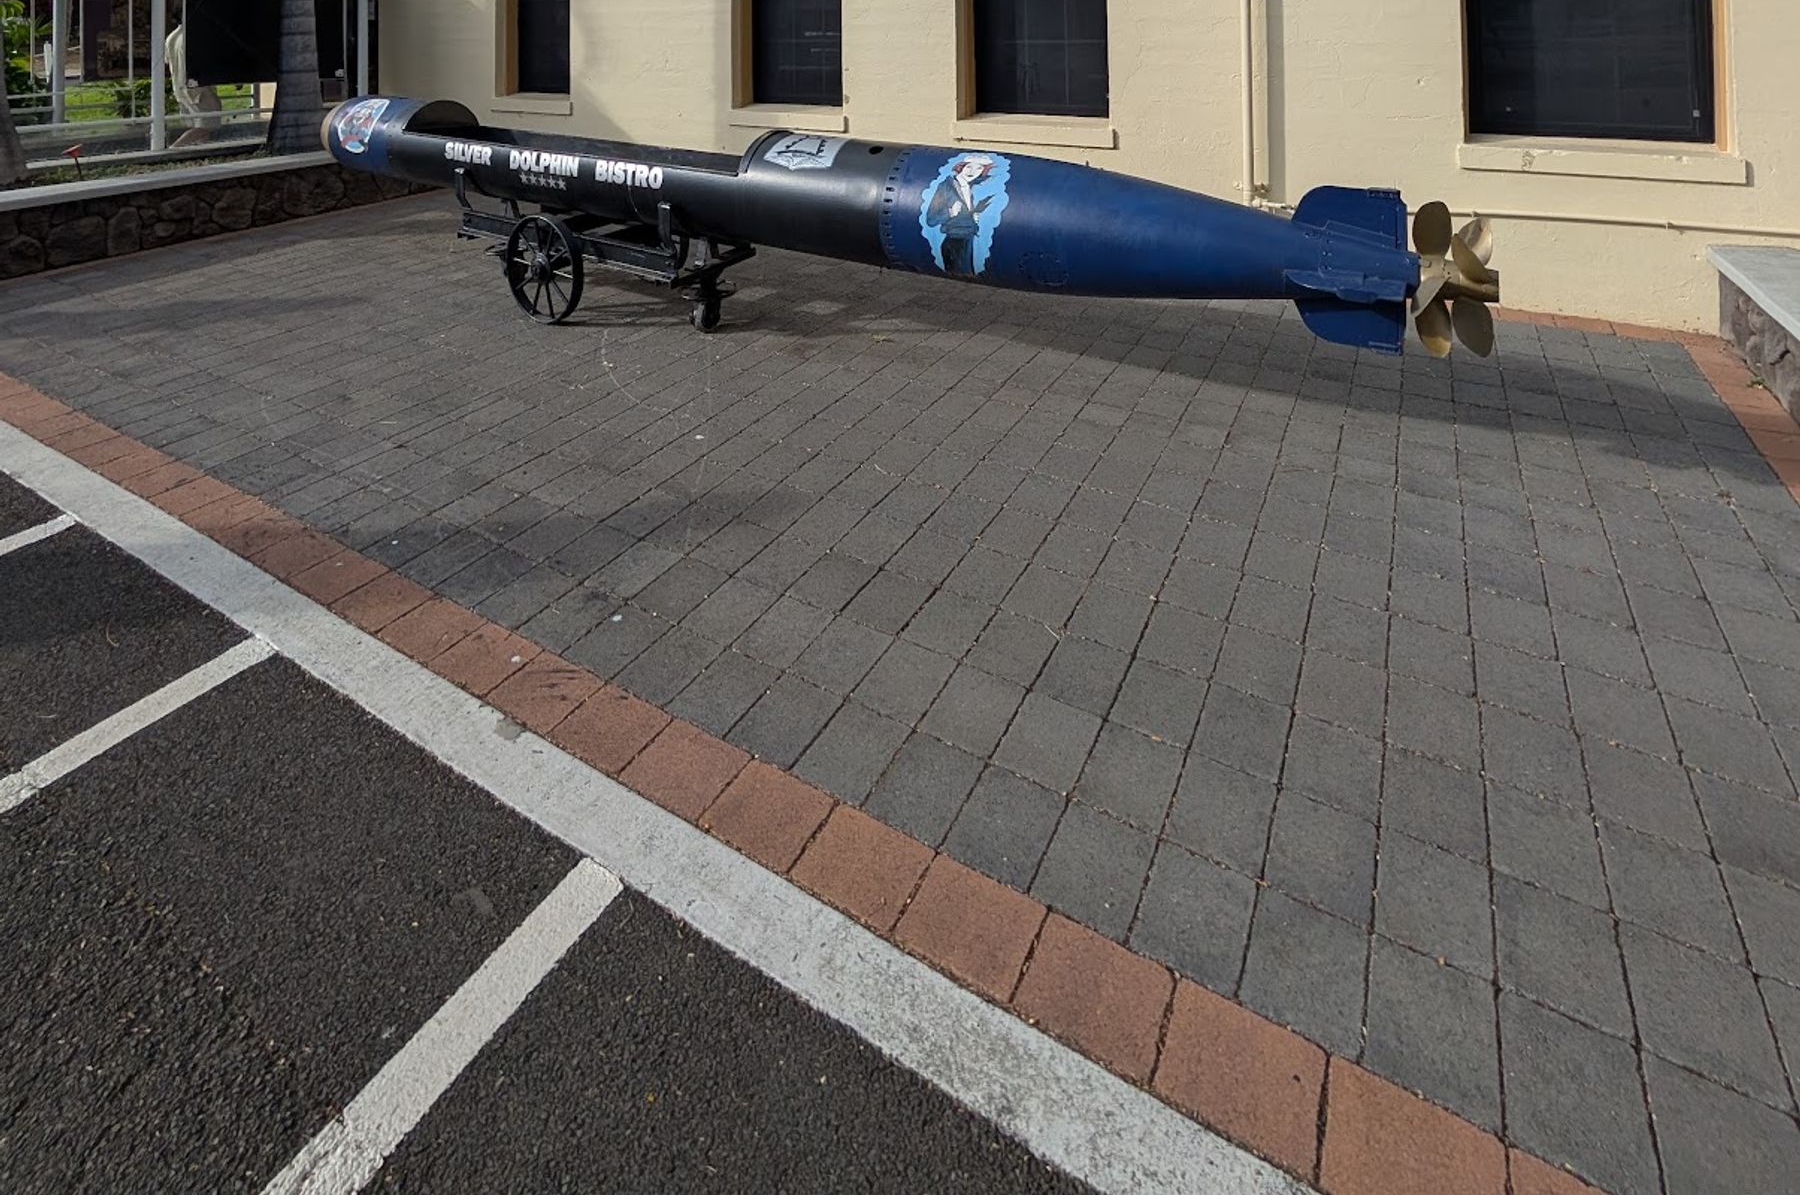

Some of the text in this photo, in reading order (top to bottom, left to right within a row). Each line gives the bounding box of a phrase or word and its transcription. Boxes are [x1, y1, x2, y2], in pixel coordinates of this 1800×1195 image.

[445, 142, 663, 189] SILVER DOLPHIN BISTRO
